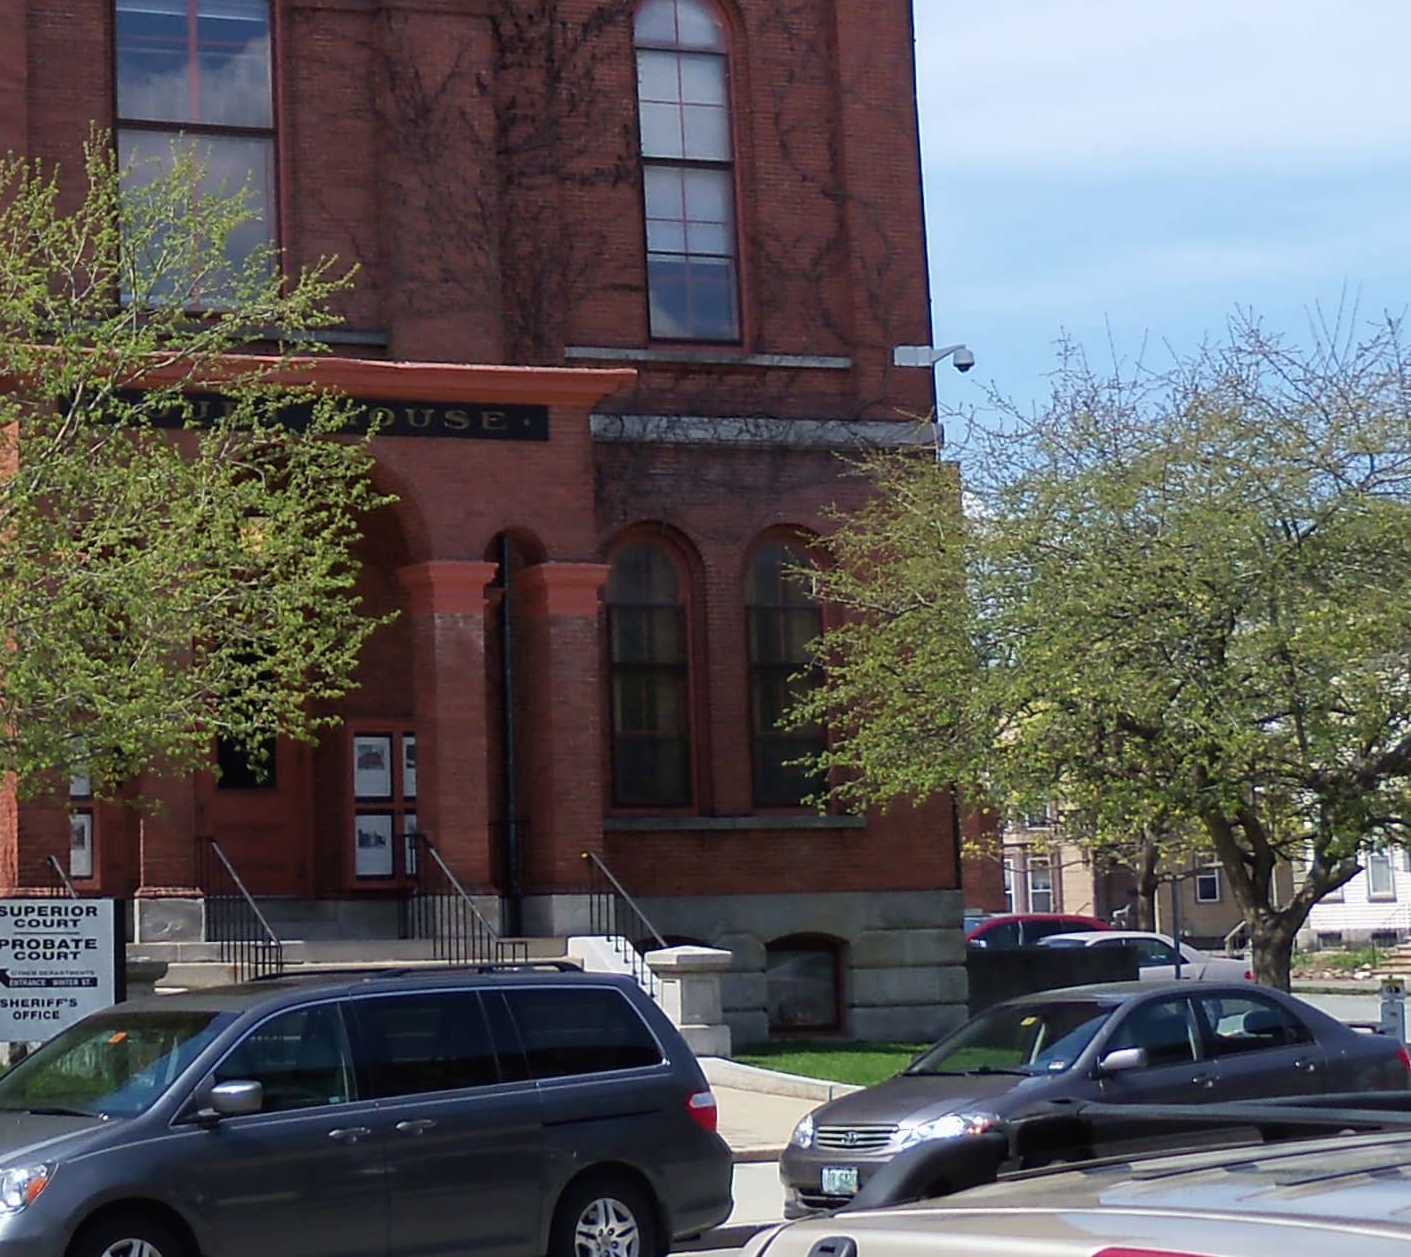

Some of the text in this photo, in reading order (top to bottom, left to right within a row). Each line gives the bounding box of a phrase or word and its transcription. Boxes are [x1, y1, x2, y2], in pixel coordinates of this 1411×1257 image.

[346, 407, 507, 430] OUSE
[14, 919, 81, 928] COURT
[13, 952, 81, 961] COURT
[9, 978, 45, 986] ENTRANCE
[0, 999, 78, 1008] SHERIFF'S
[12, 1011, 60, 1020] OFFICE
